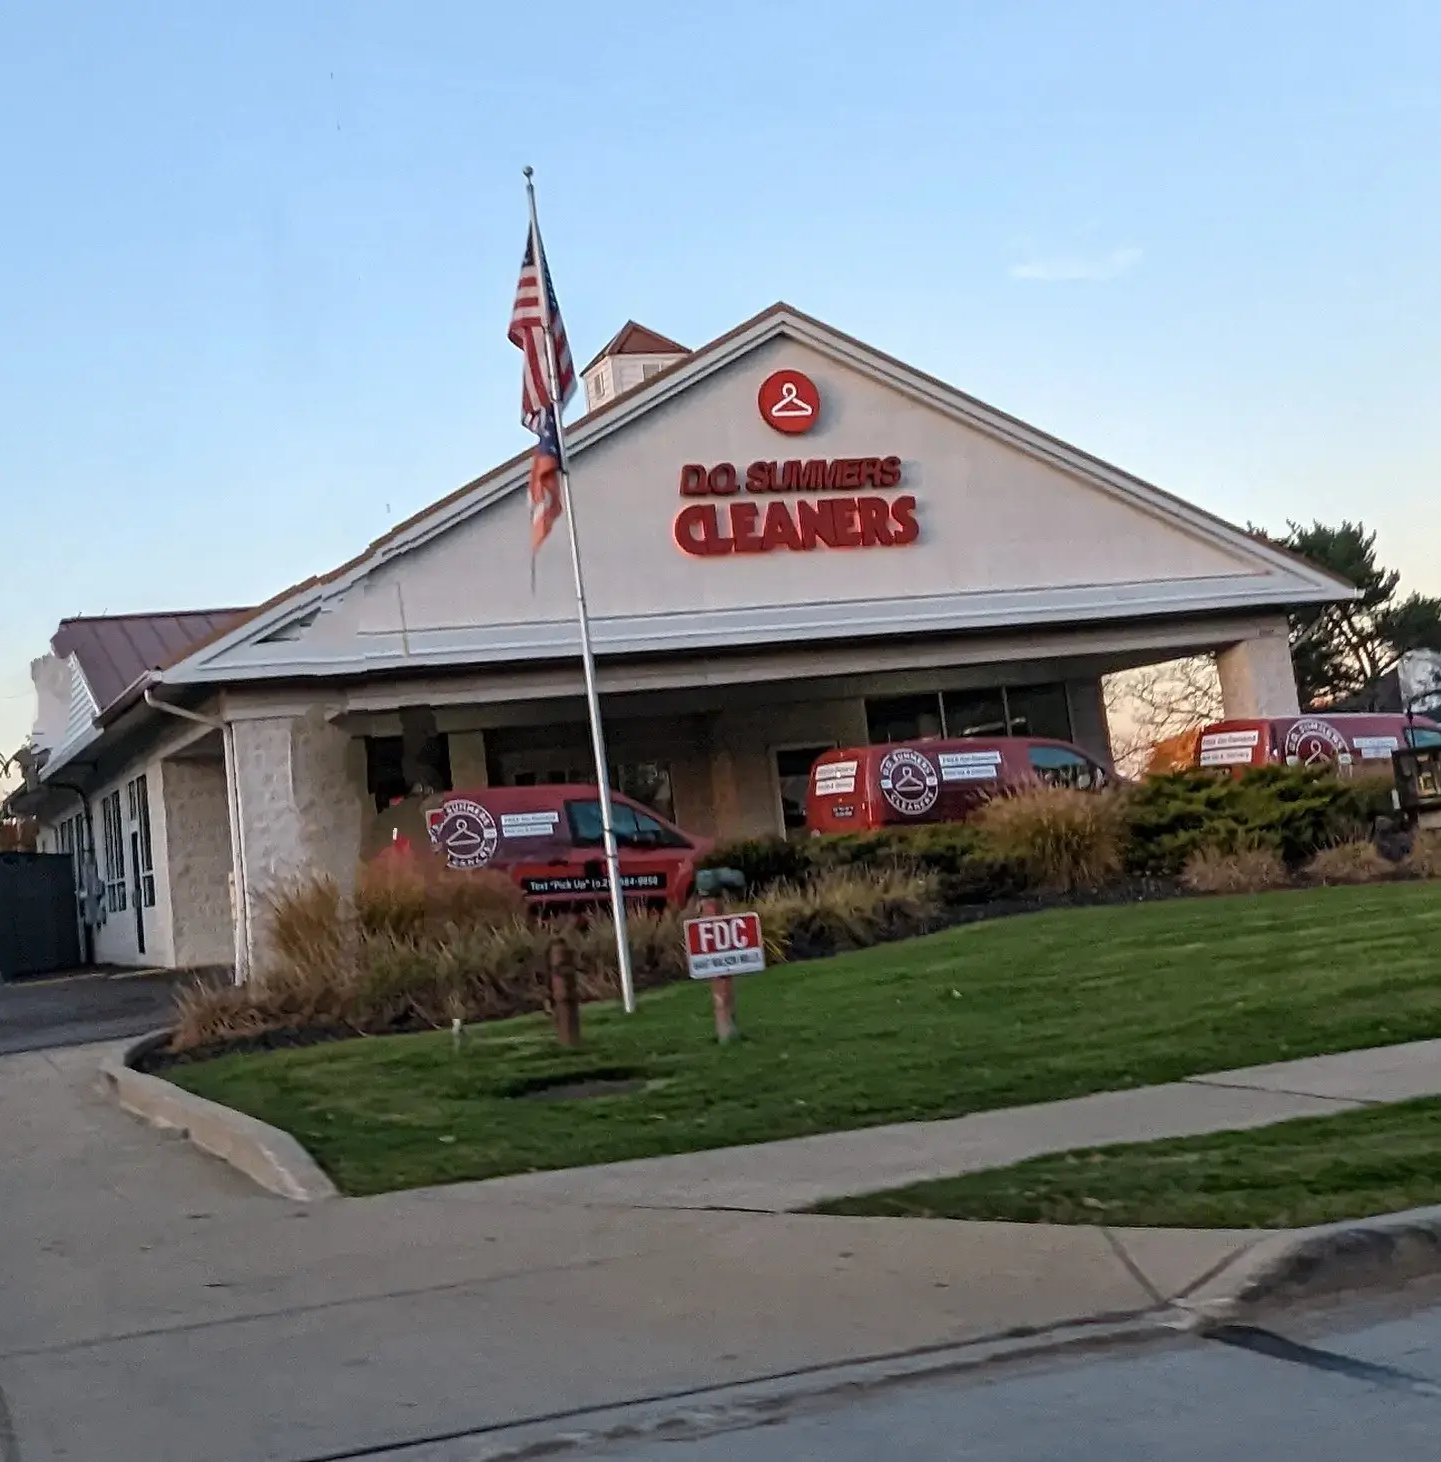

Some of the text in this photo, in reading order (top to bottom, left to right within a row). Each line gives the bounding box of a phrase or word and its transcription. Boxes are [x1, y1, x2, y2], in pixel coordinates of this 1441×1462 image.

[746, 456, 902, 494] SUMMERS
[673, 496, 920, 557] CLEANERS
[530, 881, 548, 891] Text
[698, 918, 748, 952] FDC
